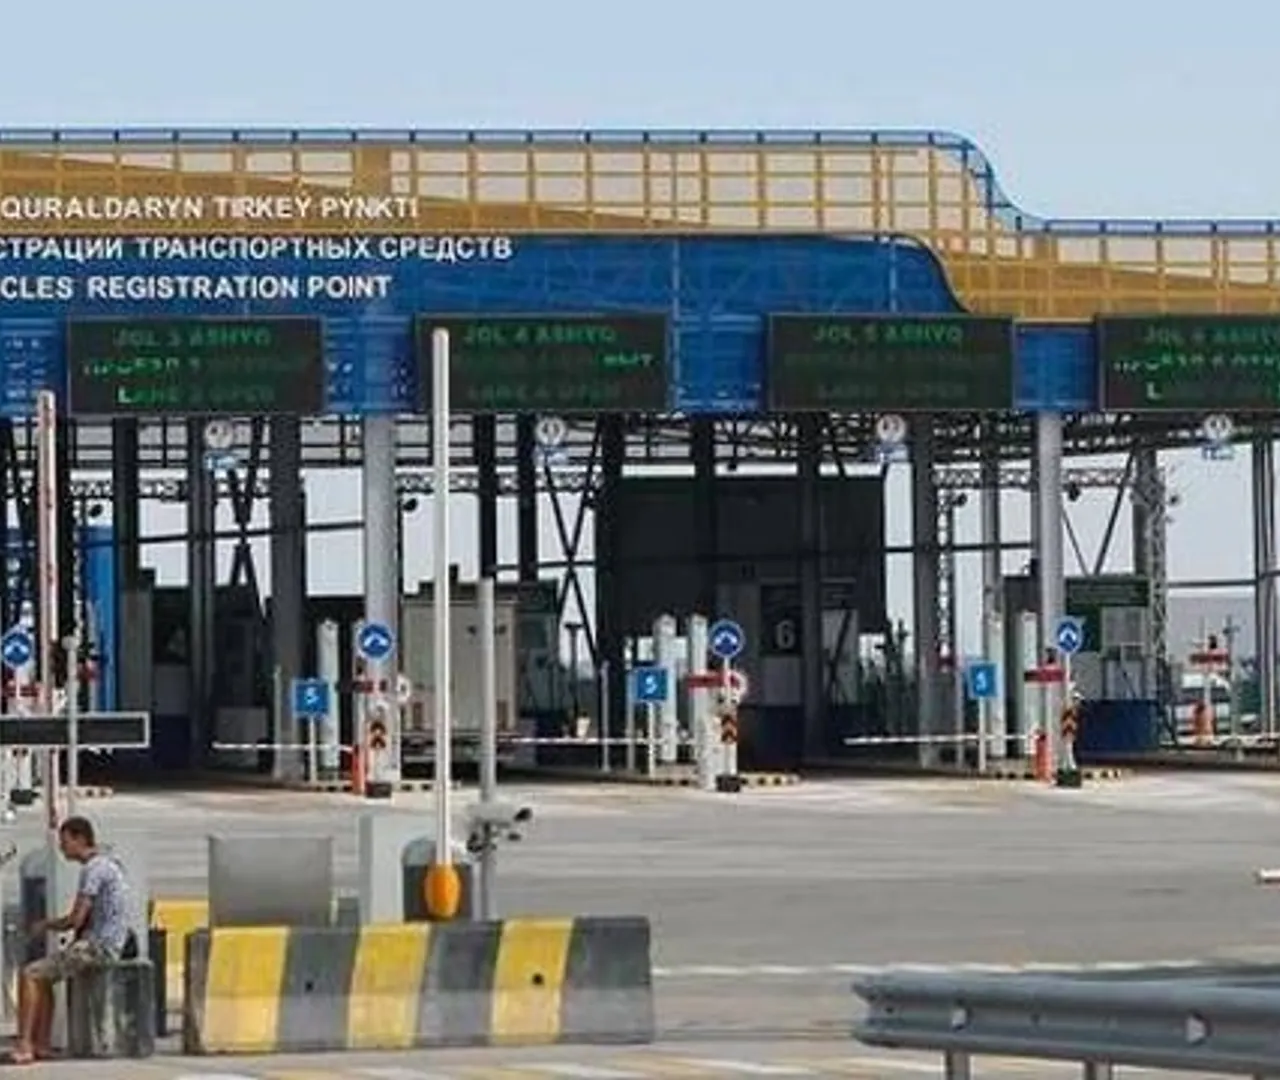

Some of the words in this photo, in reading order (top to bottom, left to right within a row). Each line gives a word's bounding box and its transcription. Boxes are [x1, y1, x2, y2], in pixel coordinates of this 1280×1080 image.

[1, 196, 201, 220] QURALDARYN
[135, 236, 371, 260] ТРАНСПОРТНЫХ
[379, 236, 513, 263] СРЕДСТВ
[87, 275, 298, 300] REGISTRATION
[307, 275, 392, 299] POINT
[776, 619, 795, 649] 6
